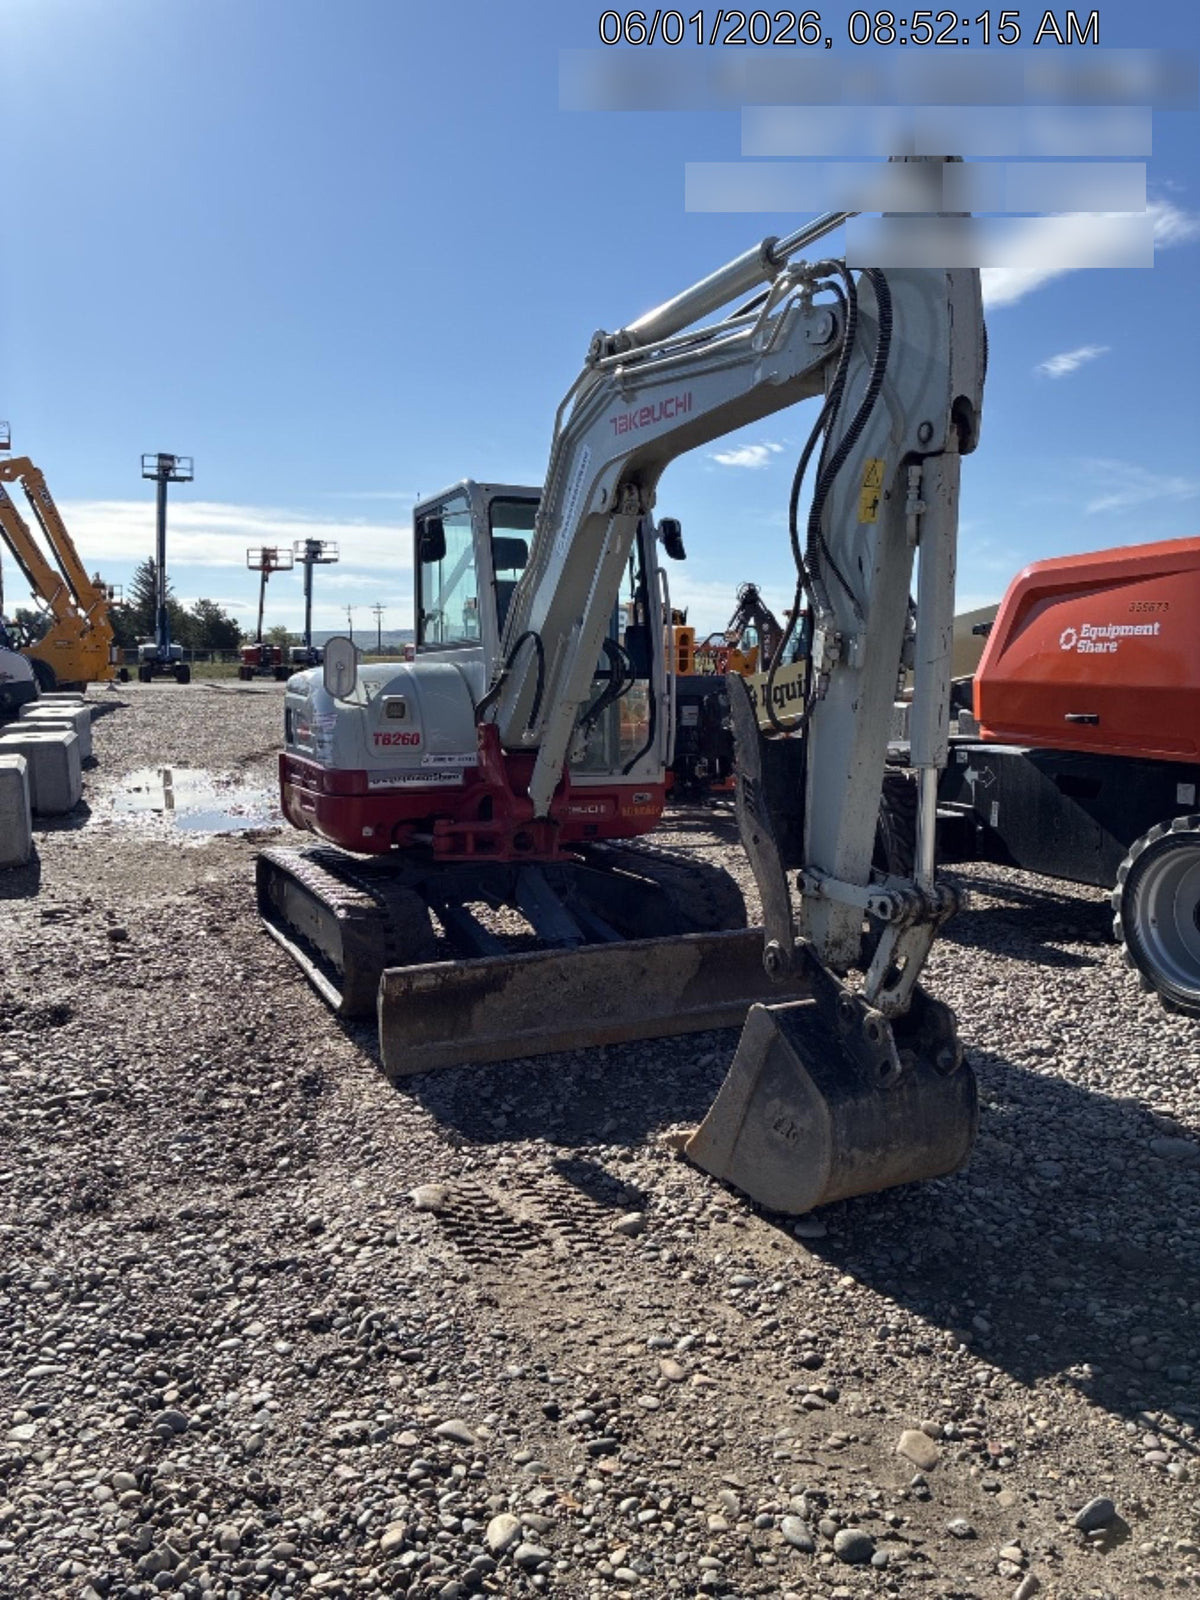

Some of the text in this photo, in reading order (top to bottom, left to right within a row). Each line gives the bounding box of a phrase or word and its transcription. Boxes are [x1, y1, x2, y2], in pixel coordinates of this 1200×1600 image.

[1080, 621, 1160, 639] Equipment
[1077, 639, 1118, 653] Share
[373, 732, 420, 746] TB260
